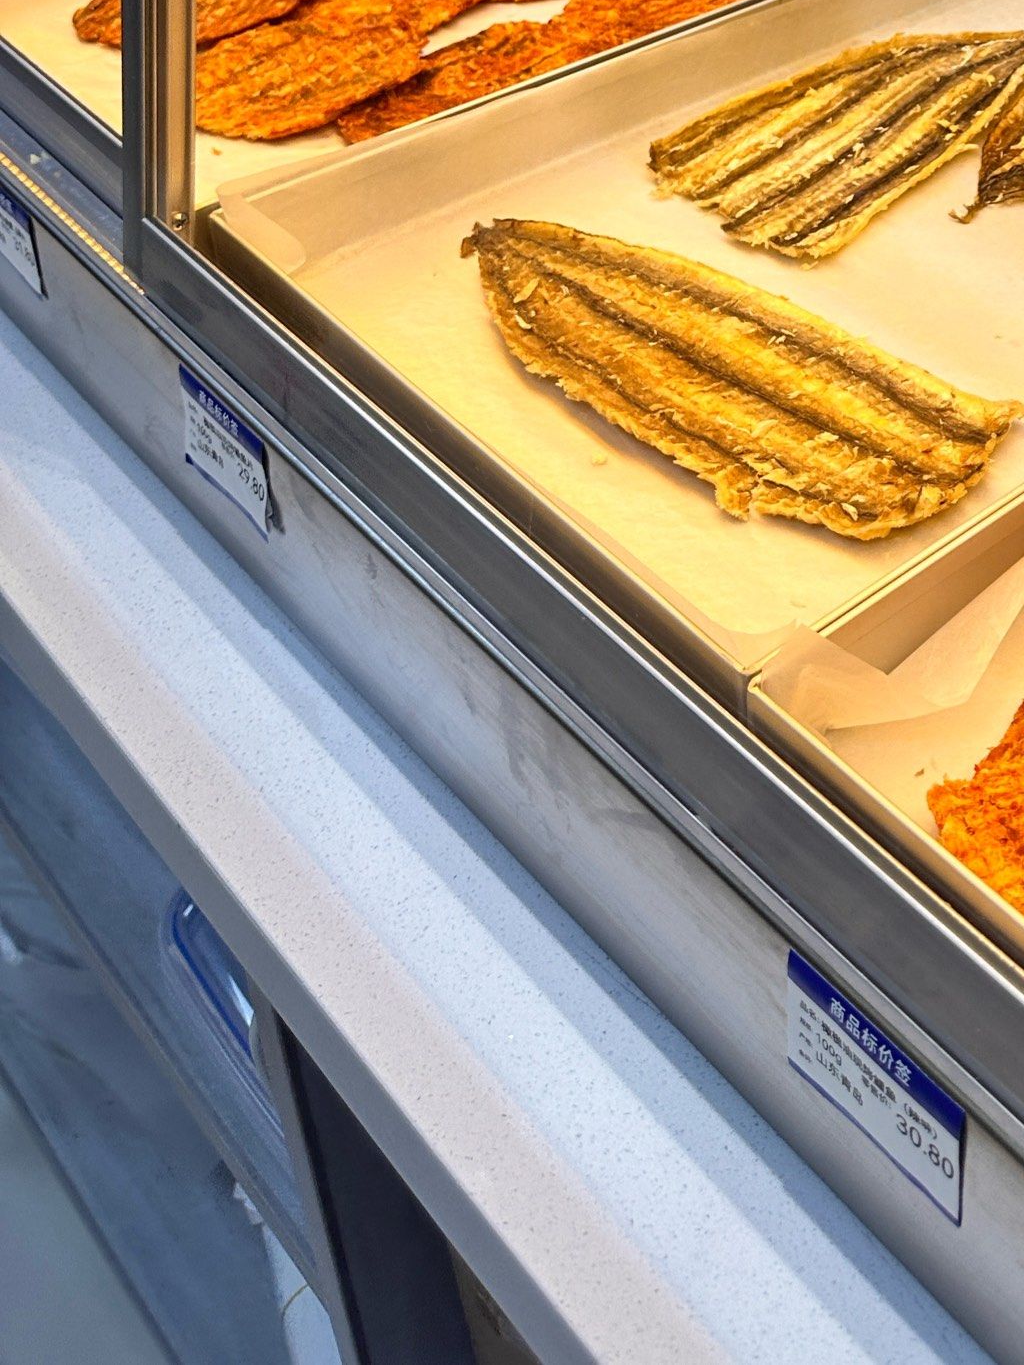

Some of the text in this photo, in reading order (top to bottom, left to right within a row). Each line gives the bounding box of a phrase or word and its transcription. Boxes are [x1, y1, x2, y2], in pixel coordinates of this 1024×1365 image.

[816, 1033, 842, 1066] 100g
[830, 997, 912, 1086] 商品标价签
[816, 1050, 863, 1106] 山东青岛
[896, 1113, 954, 1179] 30.80
